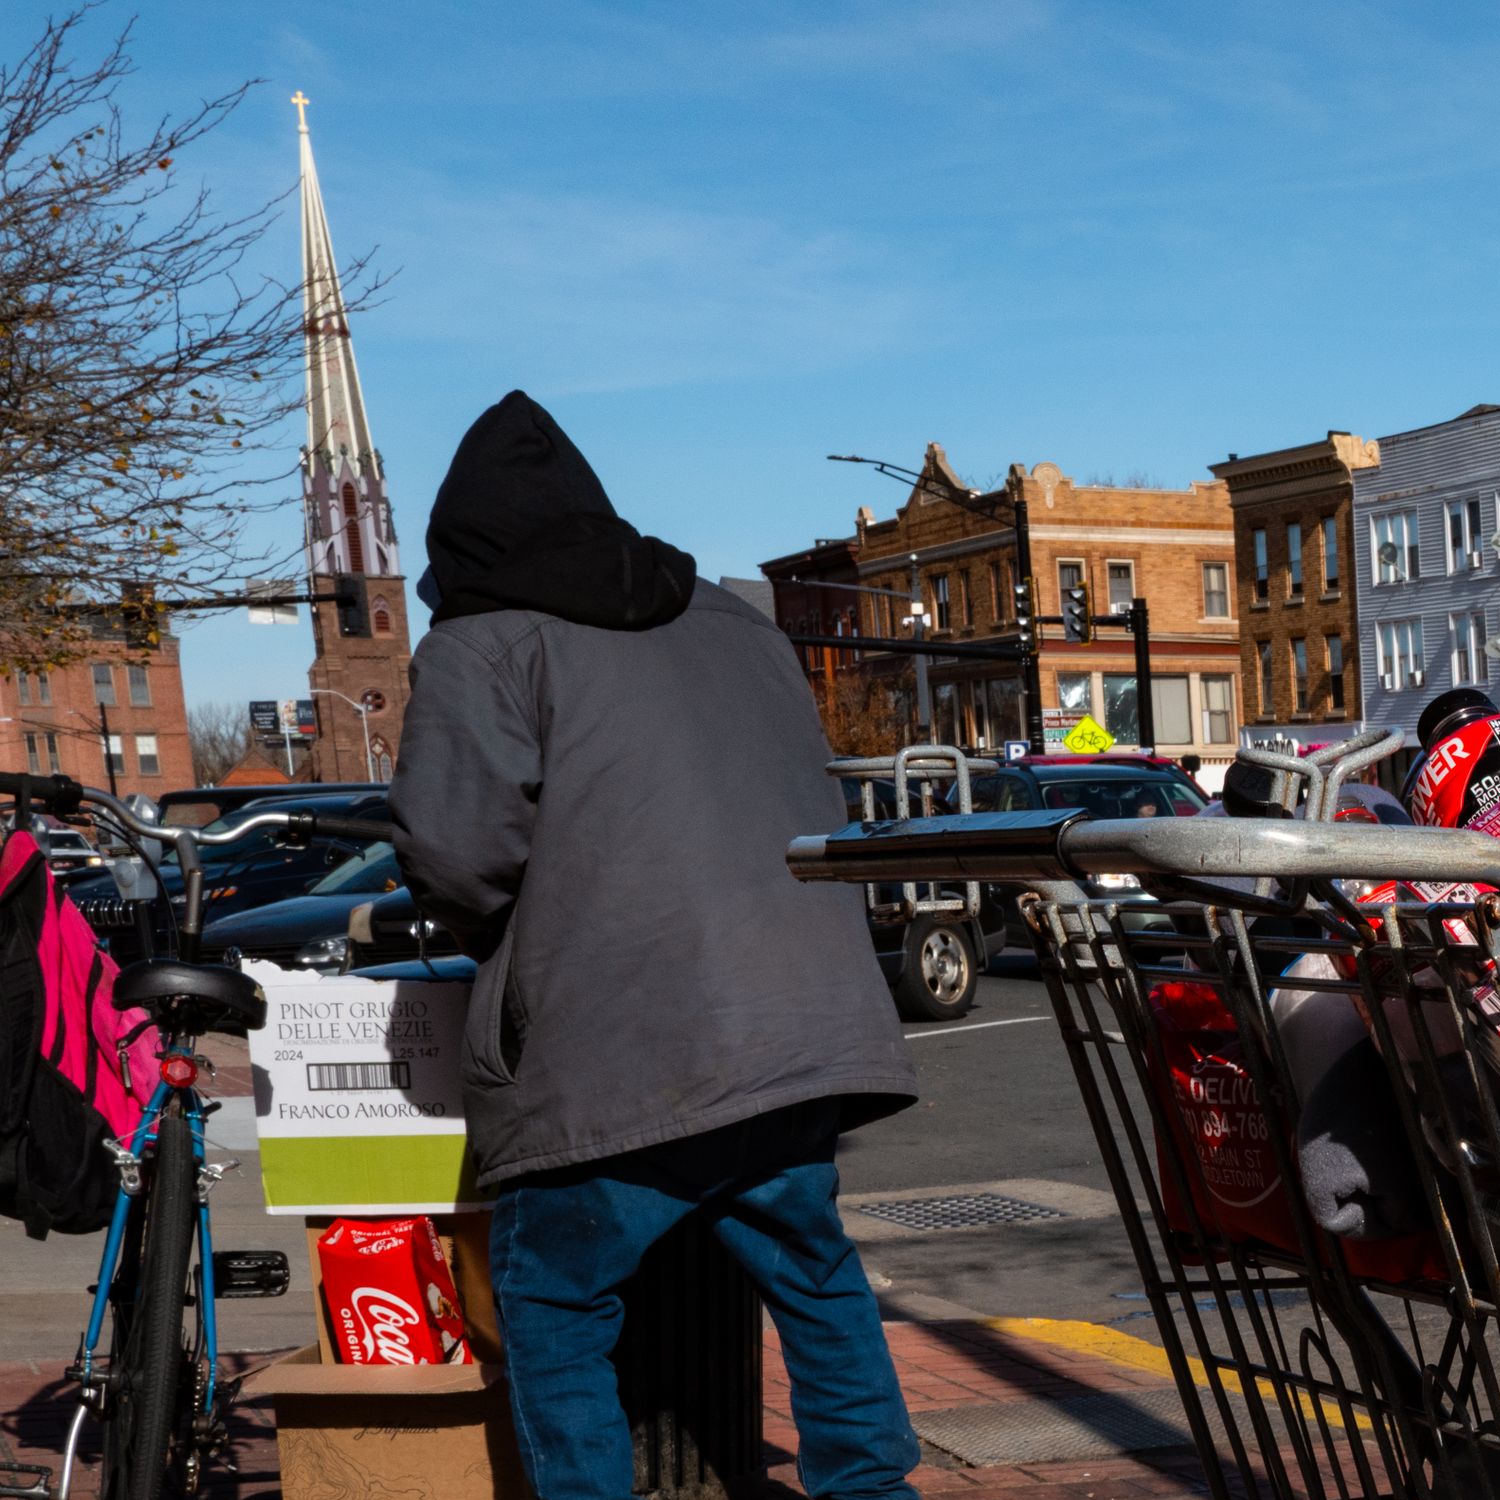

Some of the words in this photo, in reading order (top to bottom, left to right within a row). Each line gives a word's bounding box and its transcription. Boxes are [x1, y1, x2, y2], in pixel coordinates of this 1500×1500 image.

[1412, 736, 1471, 827] OWER
[279, 1002, 344, 1020] PINOT
[349, 1001, 428, 1019] GRIGIO
[277, 1022, 342, 1040] DELLE
[346, 1020, 434, 1039] VENEZIE
[274, 1050, 304, 1061] 2024
[279, 1103, 350, 1120] FRANCO
[354, 1102, 446, 1119] AMOROSO
[1201, 1110, 1269, 1141] 894-768
[1244, 1149, 1263, 1169] ST
[339, 1307, 365, 1365] ORIGIN
